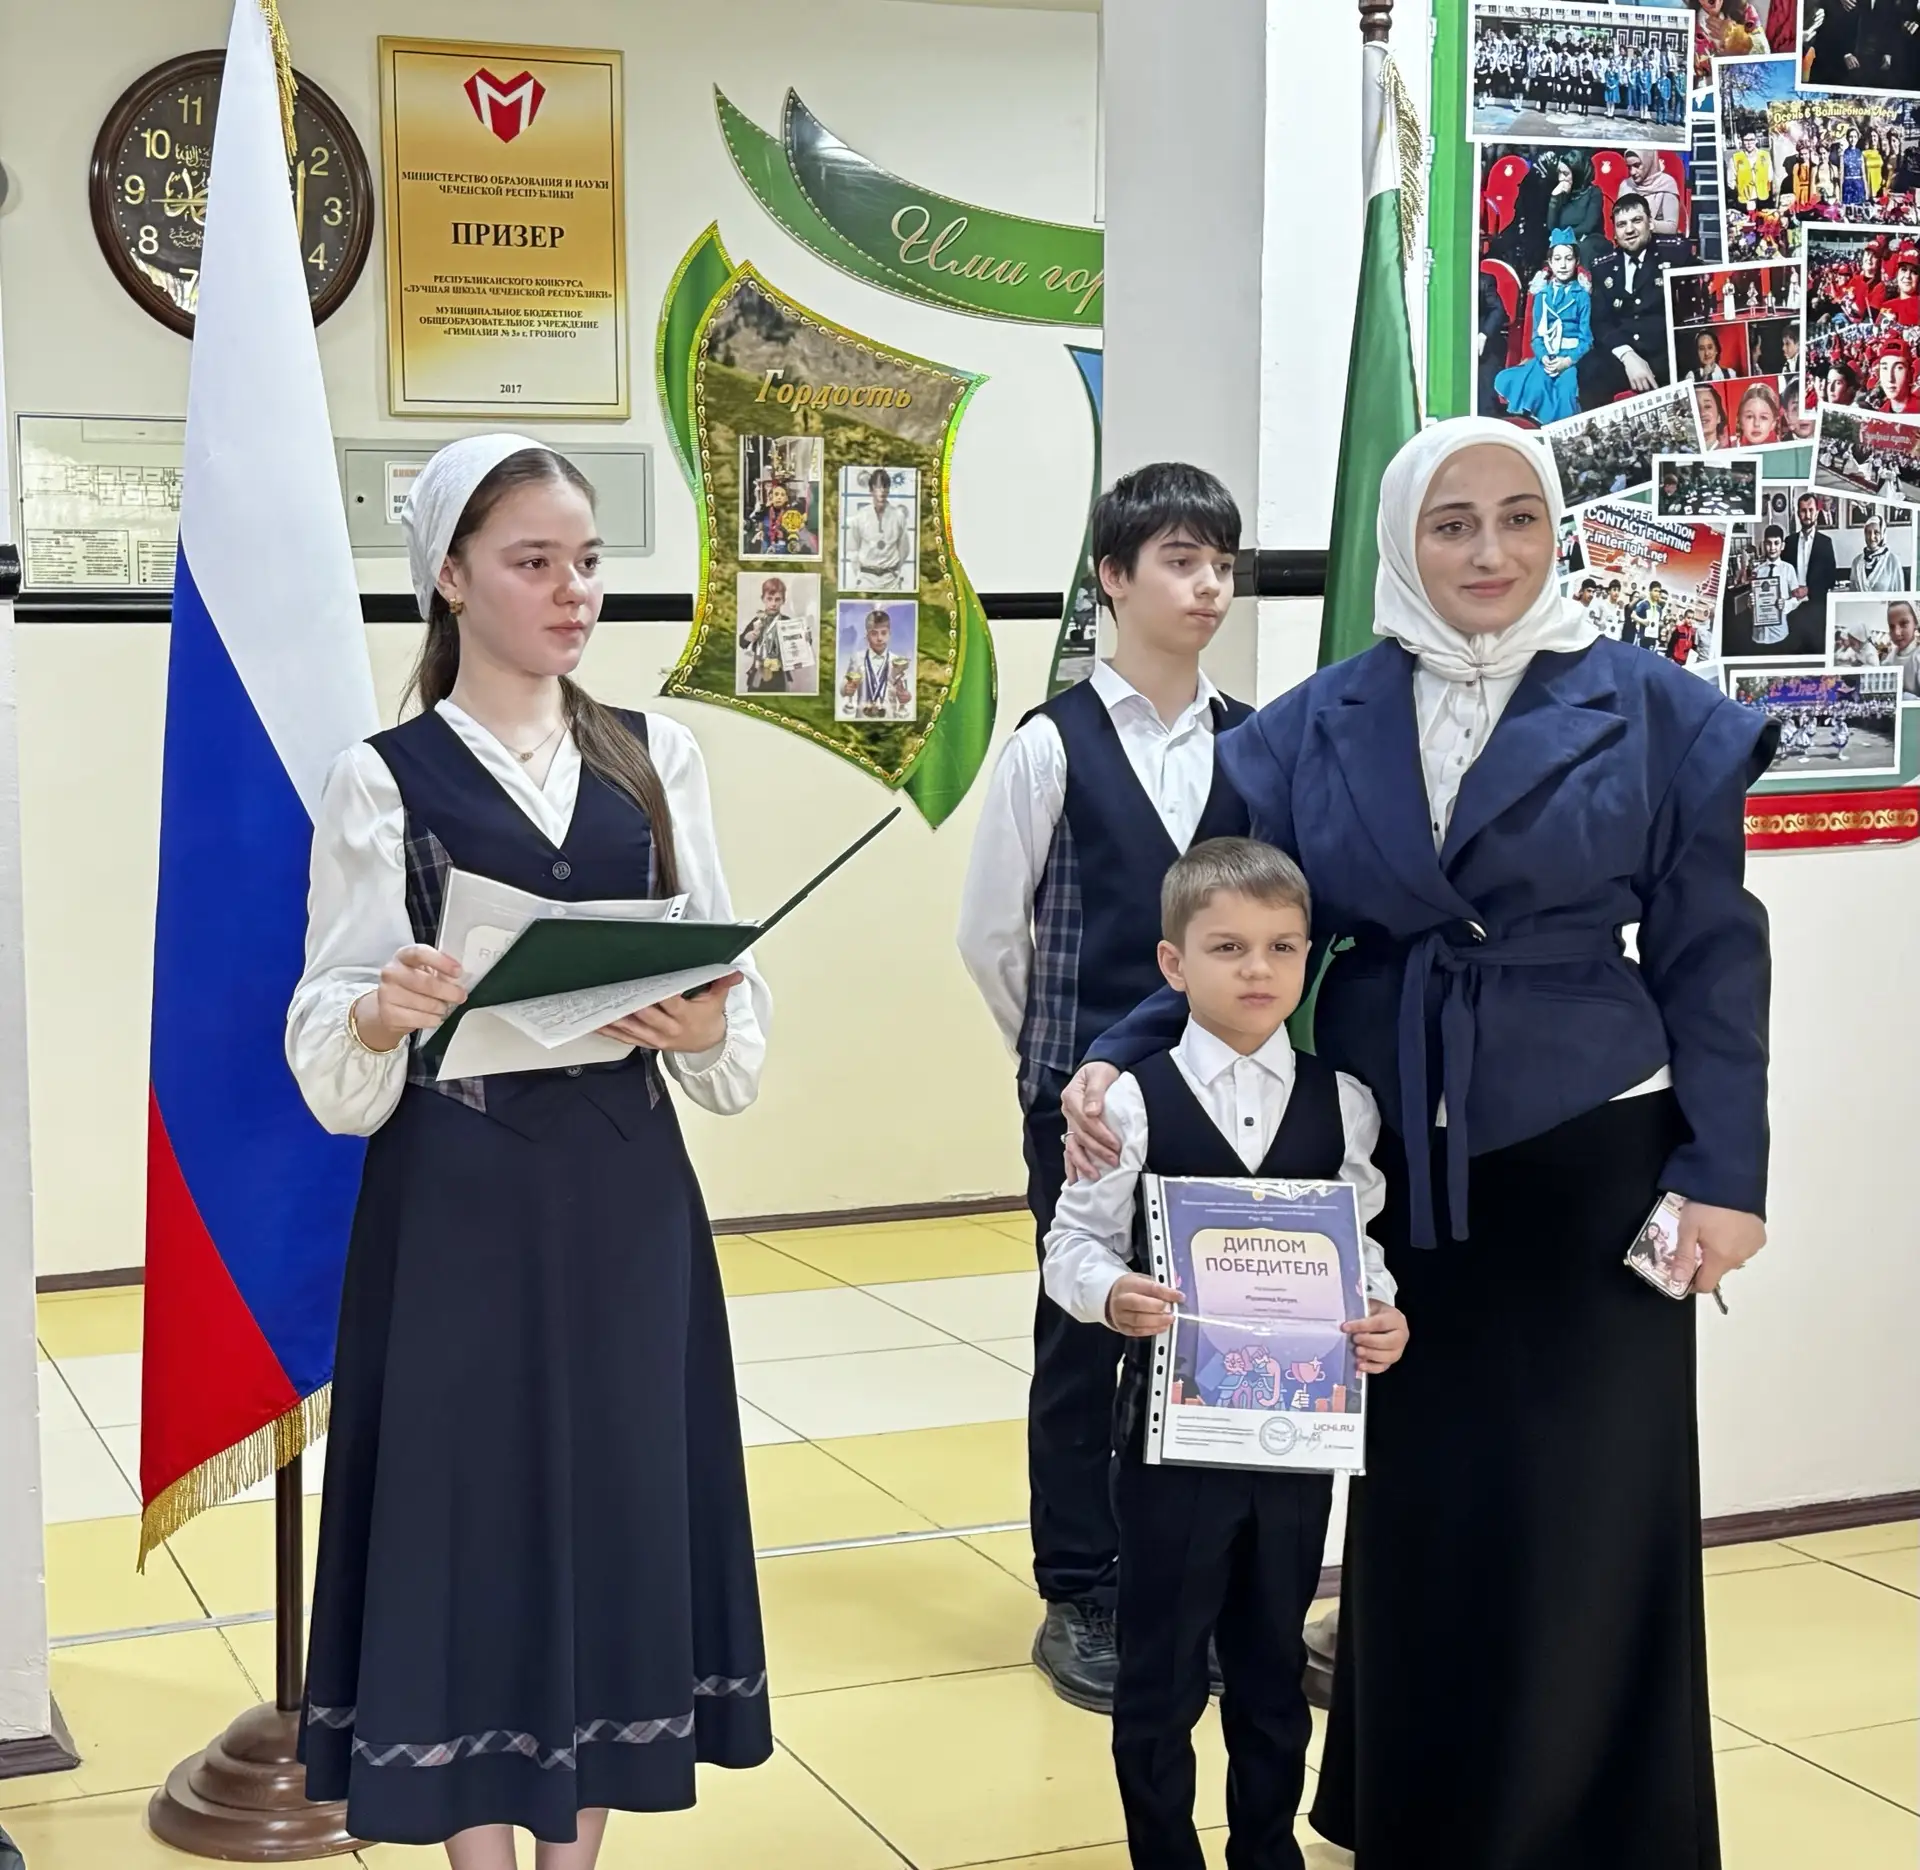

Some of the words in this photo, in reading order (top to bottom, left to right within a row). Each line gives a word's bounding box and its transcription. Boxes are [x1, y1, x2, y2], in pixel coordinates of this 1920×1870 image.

[178, 94, 202, 126] 11
[140, 128, 171, 160] 10
[310, 147, 329, 176] 2
[124, 174, 145, 205] 9
[402, 171, 488, 184] МИНИСТЕРСТВО
[490, 175, 563, 188] ОБРАЗОВАНИЯ
[565, 178, 572, 188] И
[575, 178, 609, 190] НАУКИ
[439, 184, 503, 196] ЧЕЧЕНСКОЙ
[505, 187, 574, 199] РЕСПУБЛИКИ
[322, 197, 343, 226] 3
[138, 225, 159, 255] 8
[451, 222, 565, 249] ПРИЗЕР
[308, 242, 328, 271] 4
[433, 275, 533, 287] РЕСПУБЛИКАНСКОГО
[535, 278, 584, 288] КОНКУРСА
[452, 286, 487, 296] ШКОЛА
[489, 287, 546, 297] ЧЕЧЕНСКОЙ
[419, 316, 535, 328] ОБЩЕОБРАЗОВАТЕЛЬНОЕ
[537, 319, 599, 329] УЧРЕЖДЕНИЕ
[435, 306, 522, 317] МУНИЦИПАЛЬНОЕ
[523, 309, 583, 319] БЮДЖЕТНОЕ
[529, 329, 576, 339] ГРОЗНОГО
[500, 384, 522, 394] 2017
[754, 368, 913, 413] Гордость
[1646, 528, 1692, 553] FIGHTING
[1223, 1237, 1306, 1254] ДИПЛОМ
[1206, 1257, 1329, 1277] ПОБЕДИТЕЛЯ
